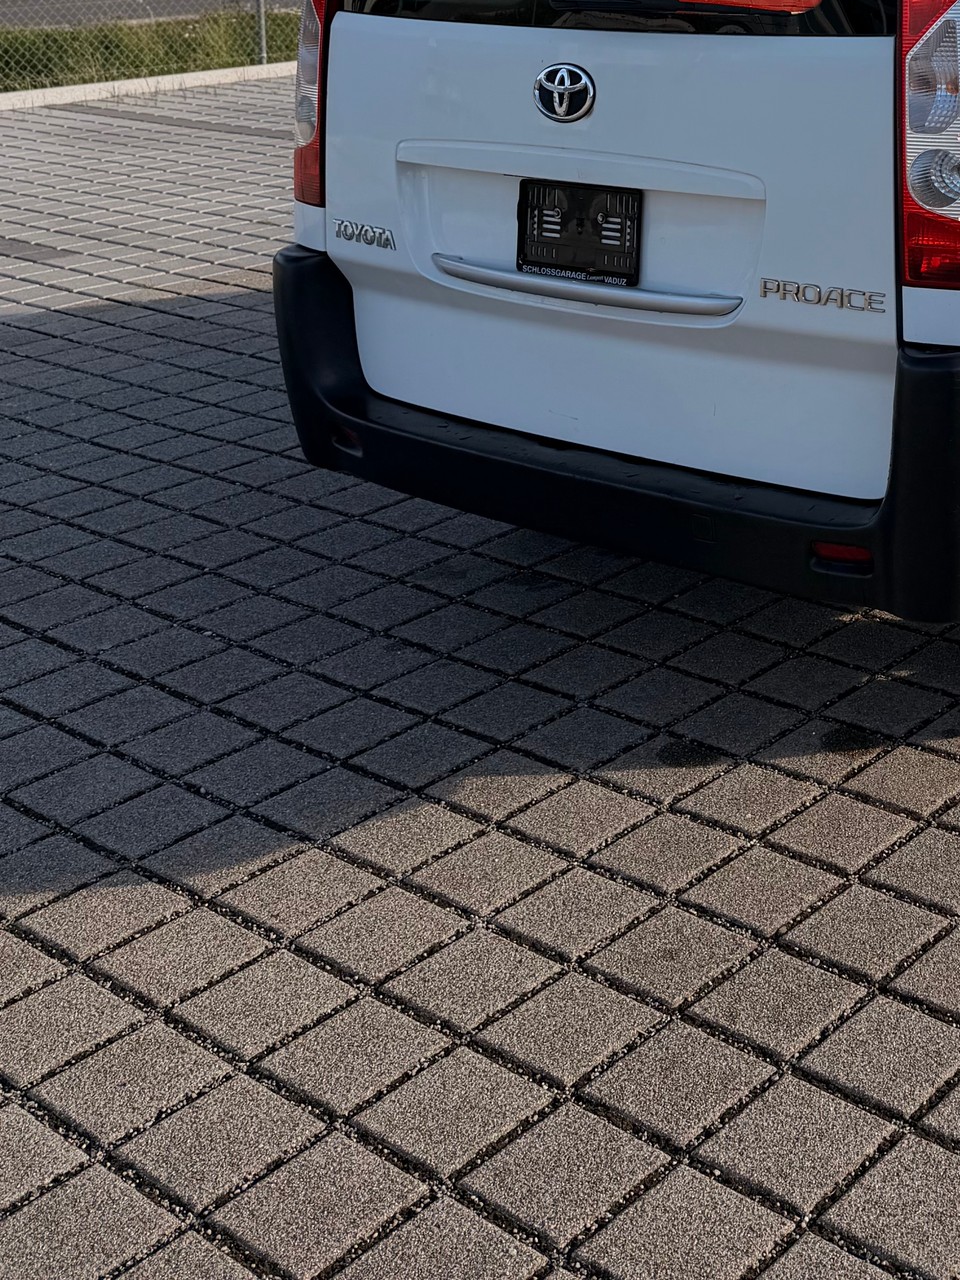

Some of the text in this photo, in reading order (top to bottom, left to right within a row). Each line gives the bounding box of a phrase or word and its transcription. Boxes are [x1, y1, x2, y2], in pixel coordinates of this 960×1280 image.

[332, 218, 397, 251] TOYOTA
[522, 264, 587, 280] SCHLOSSGARAGE
[604, 276, 627, 286] VADUZ
[759, 277, 886, 313] PROACE
